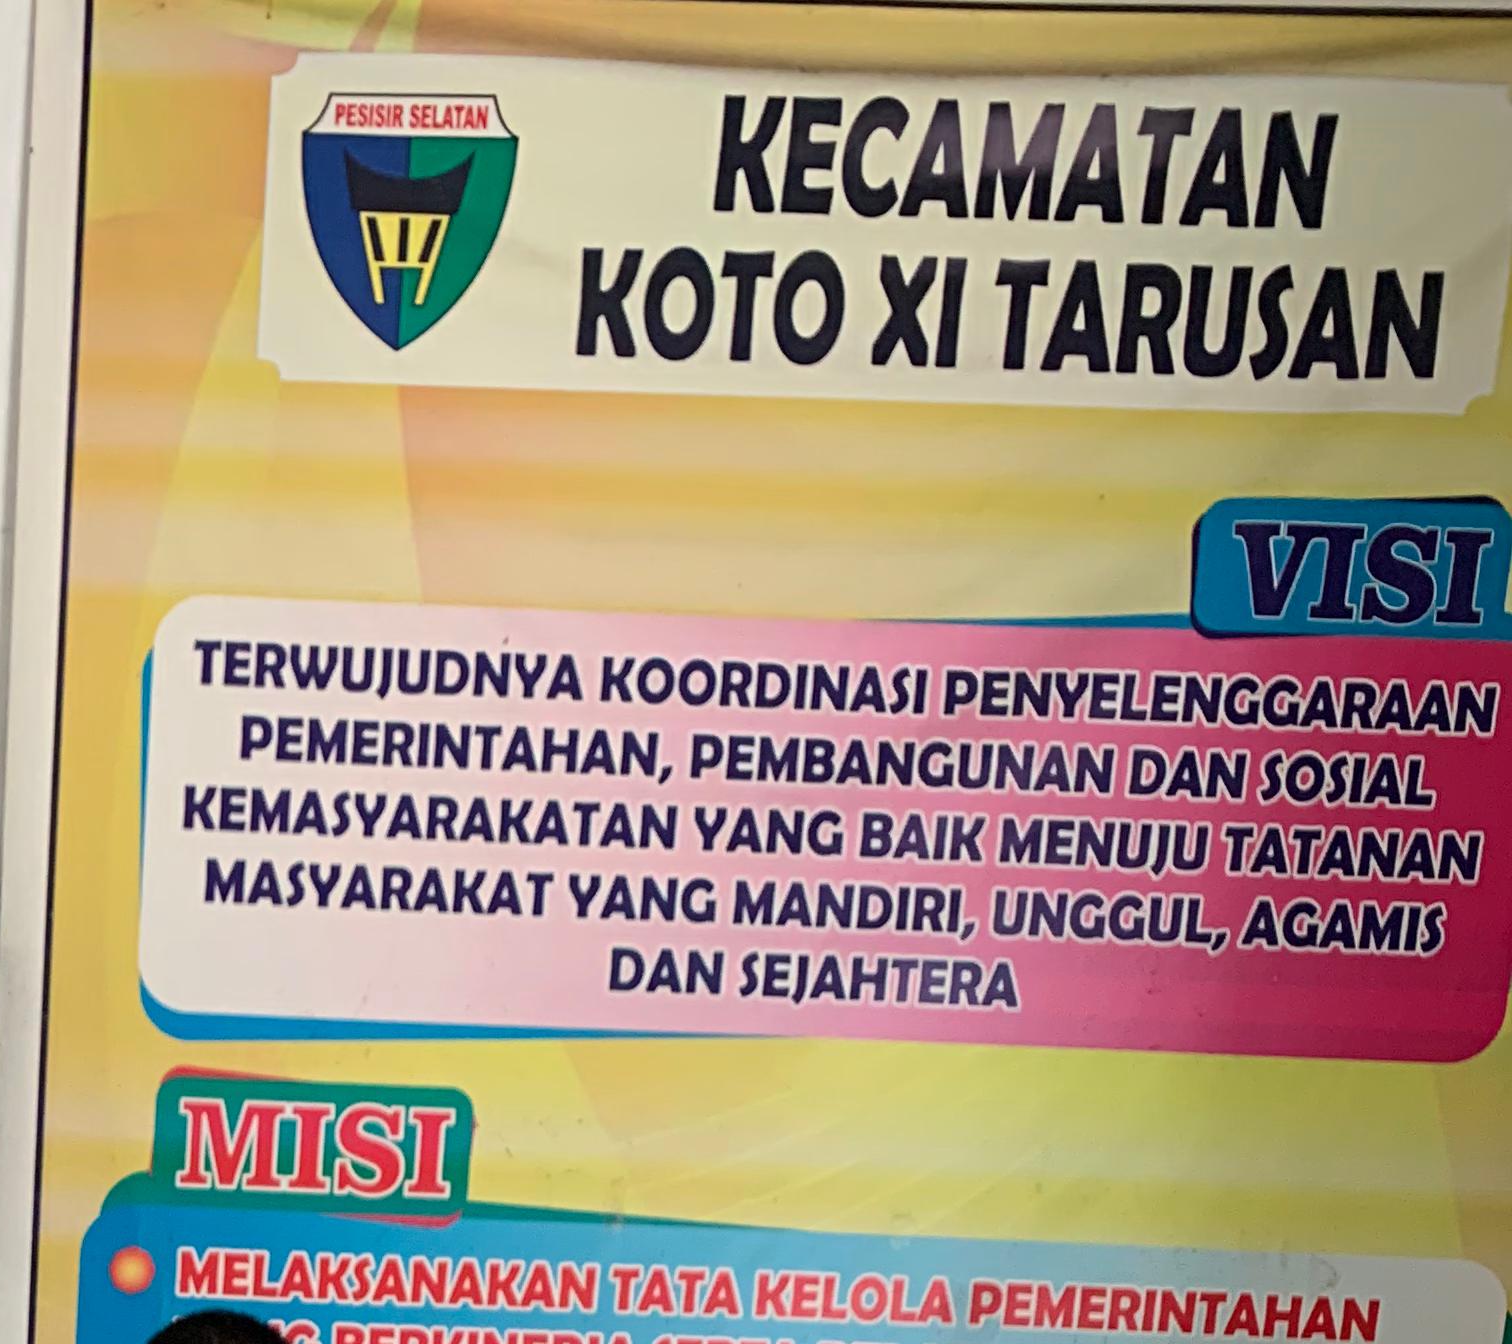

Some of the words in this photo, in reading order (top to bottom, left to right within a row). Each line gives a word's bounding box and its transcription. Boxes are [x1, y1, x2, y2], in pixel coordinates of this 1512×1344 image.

[334, 104, 404, 128] PESISIR
[410, 104, 489, 130] SELATAN
[714, 95, 1338, 229] KECAMATAN
[576, 246, 845, 365] KOTO
[871, 254, 968, 367] XI
[995, 258, 1445, 380] TARUSAN
[1234, 521, 1493, 625] VISI
[194, 640, 583, 700] TERWUJUDNYA
[600, 656, 928, 715] KOORDINASI
[943, 667, 1498, 733] PENYELENGGARAAN
[240, 715, 672, 784] PEMERINTAHAN,
[689, 734, 1115, 794] PEMBANGUNAN
[1127, 748, 1248, 800] DAN
[1257, 752, 1435, 806] SOSIAL
[183, 785, 678, 849] KEMASYARAKATAN
[694, 806, 843, 856] YANG
[860, 812, 986, 861] BAIK
[999, 817, 1208, 878] MENUJU
[1223, 826, 1482, 882] TATANAN
[204, 858, 553, 916] MASYARAKAT
[568, 874, 717, 922] YANG
[732, 880, 976, 940] MANDIRI,
[992, 889, 1228, 953] UNGGUL,
[1240, 898, 1445, 954] AGAMIS
[609, 947, 724, 994] DAN
[739, 951, 1020, 1009] SEJAHTERA
[175, 1097, 454, 1198] MISI
[176, 1247, 599, 1310] MELAKSANAKAN
[610, 1266, 740, 1315] TATA
[755, 1271, 953, 1327] KELOLA
[968, 1280, 1380, 1342] PEMERINTAHAN
